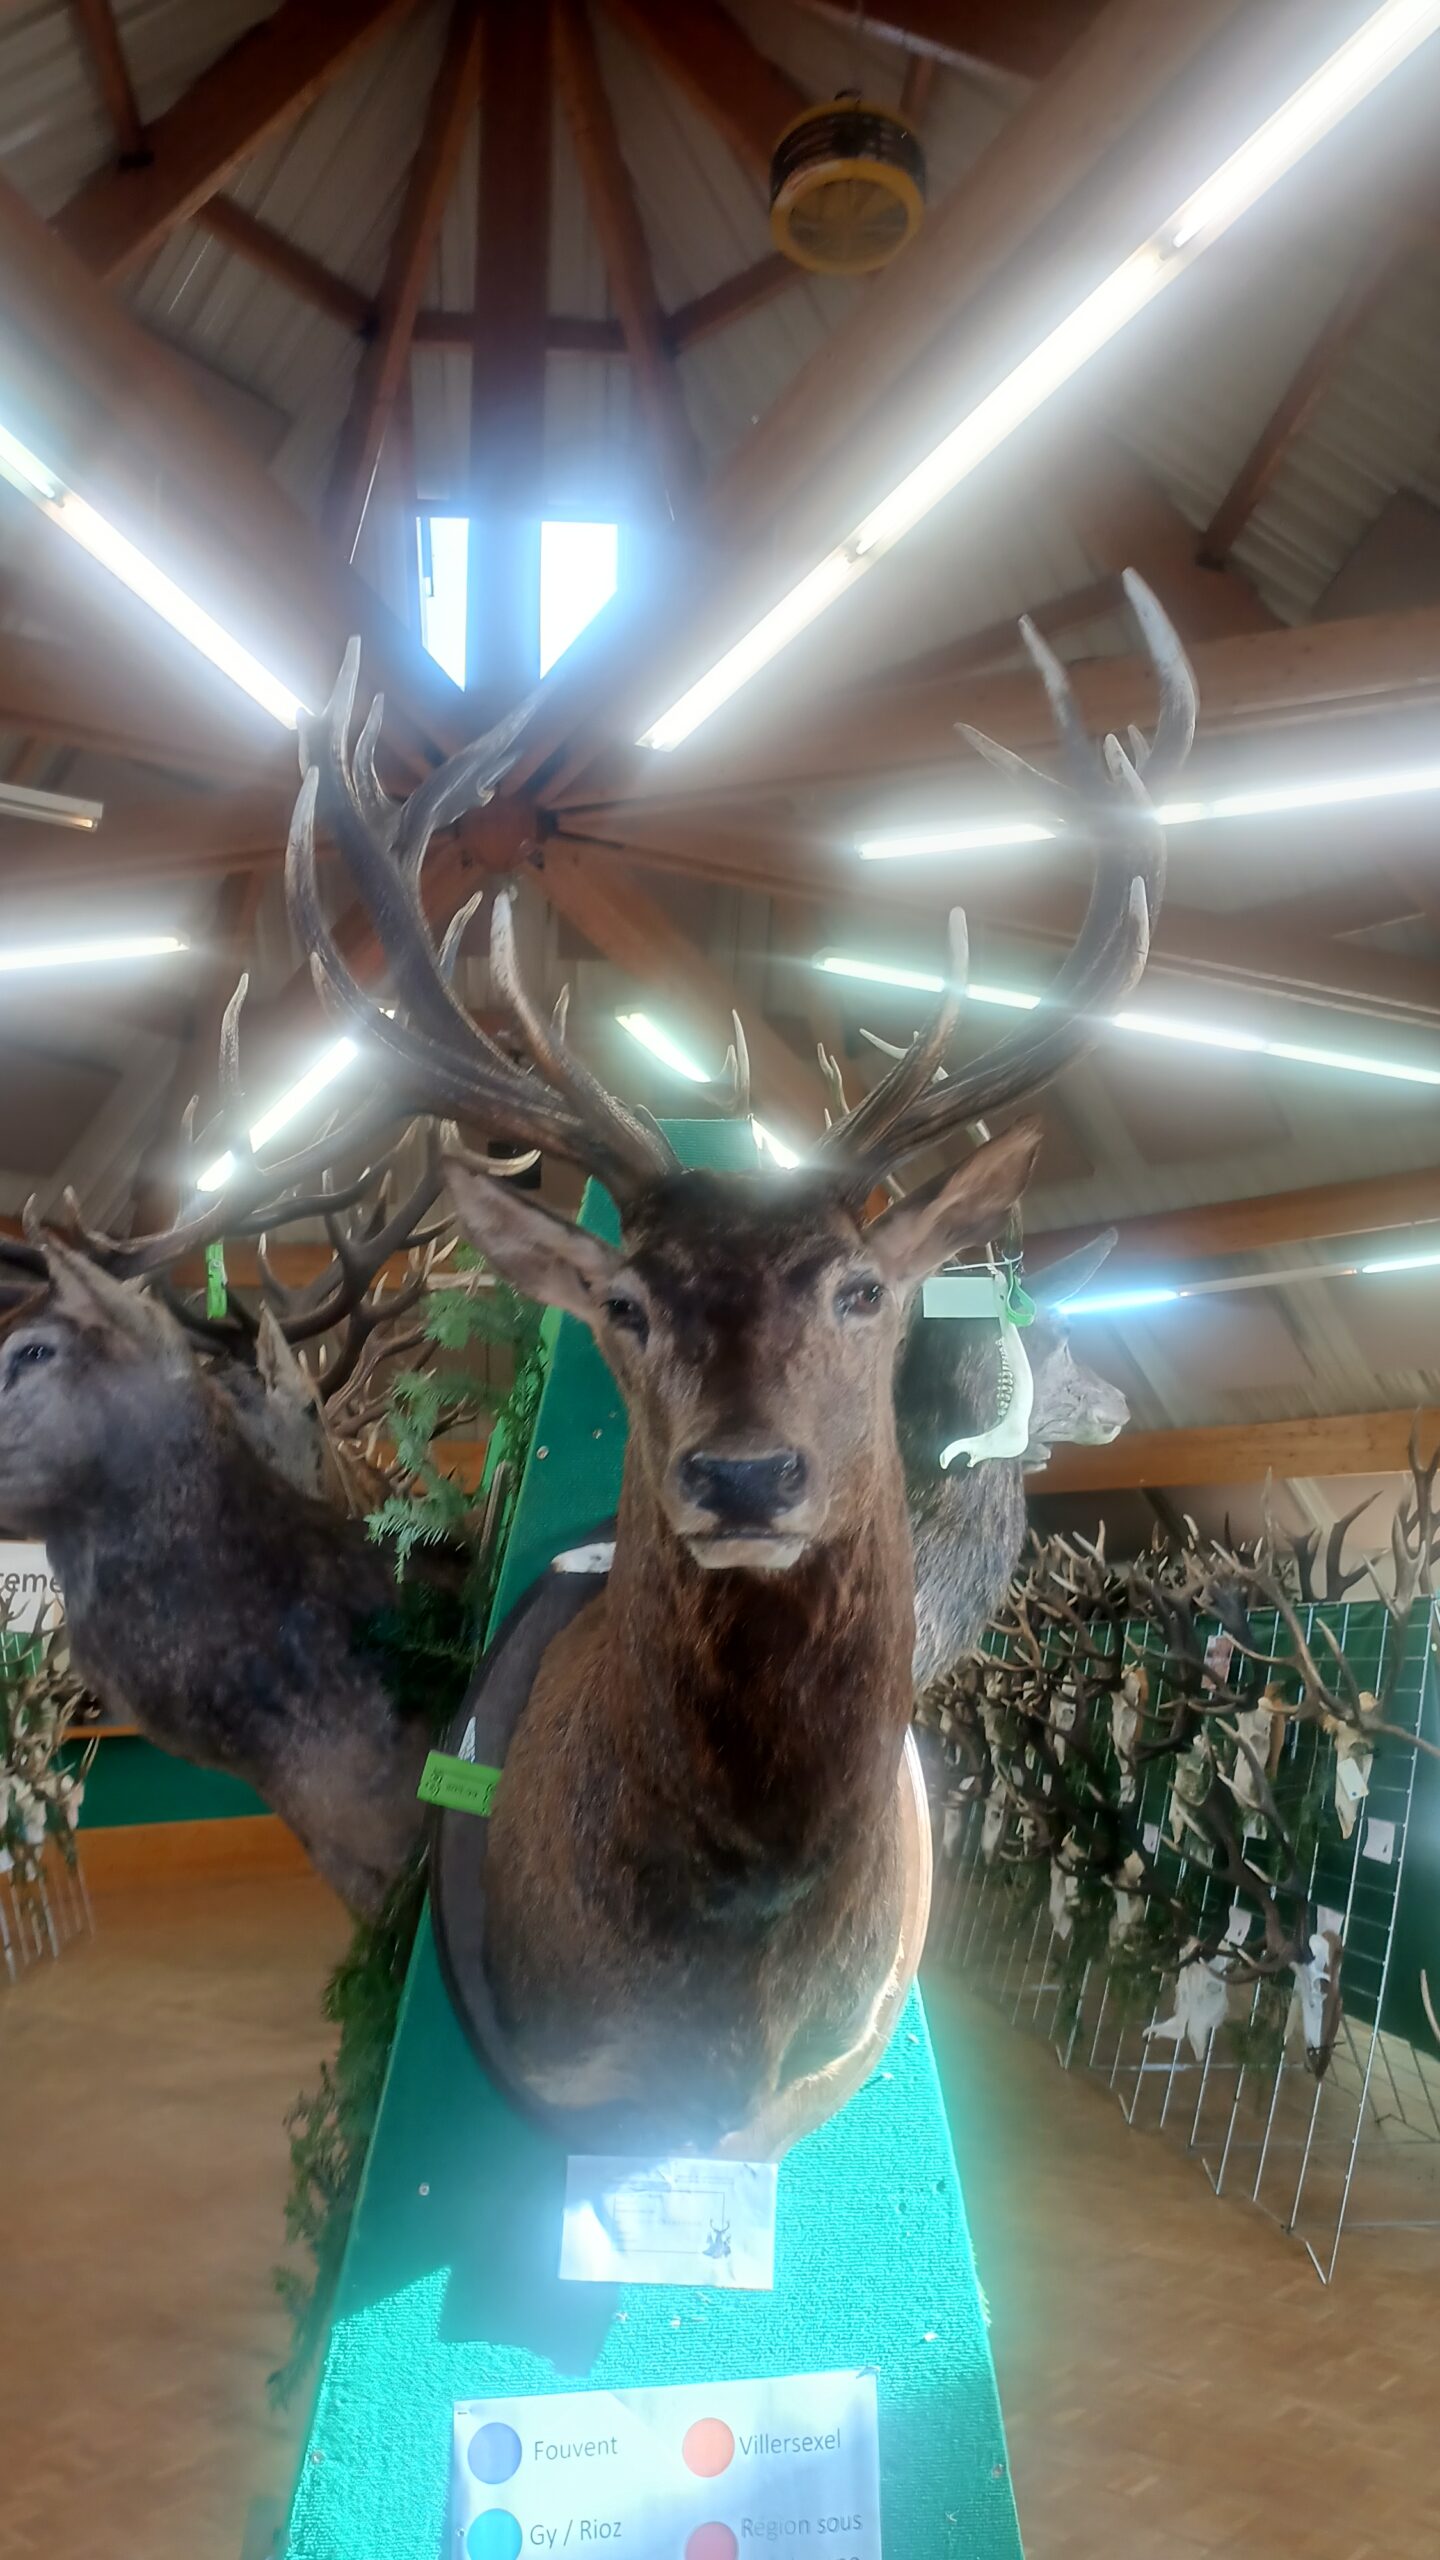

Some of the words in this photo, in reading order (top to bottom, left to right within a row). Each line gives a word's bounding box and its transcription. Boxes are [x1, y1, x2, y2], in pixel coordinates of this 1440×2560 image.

[534, 2436, 619, 2461] Fouvent
[739, 2427, 841, 2456] Villersexel
[530, 2524, 557, 2550] Gy
[563, 2519, 573, 2547] /
[580, 2518, 622, 2541] Rioz
[817, 2514, 863, 2535] sous
